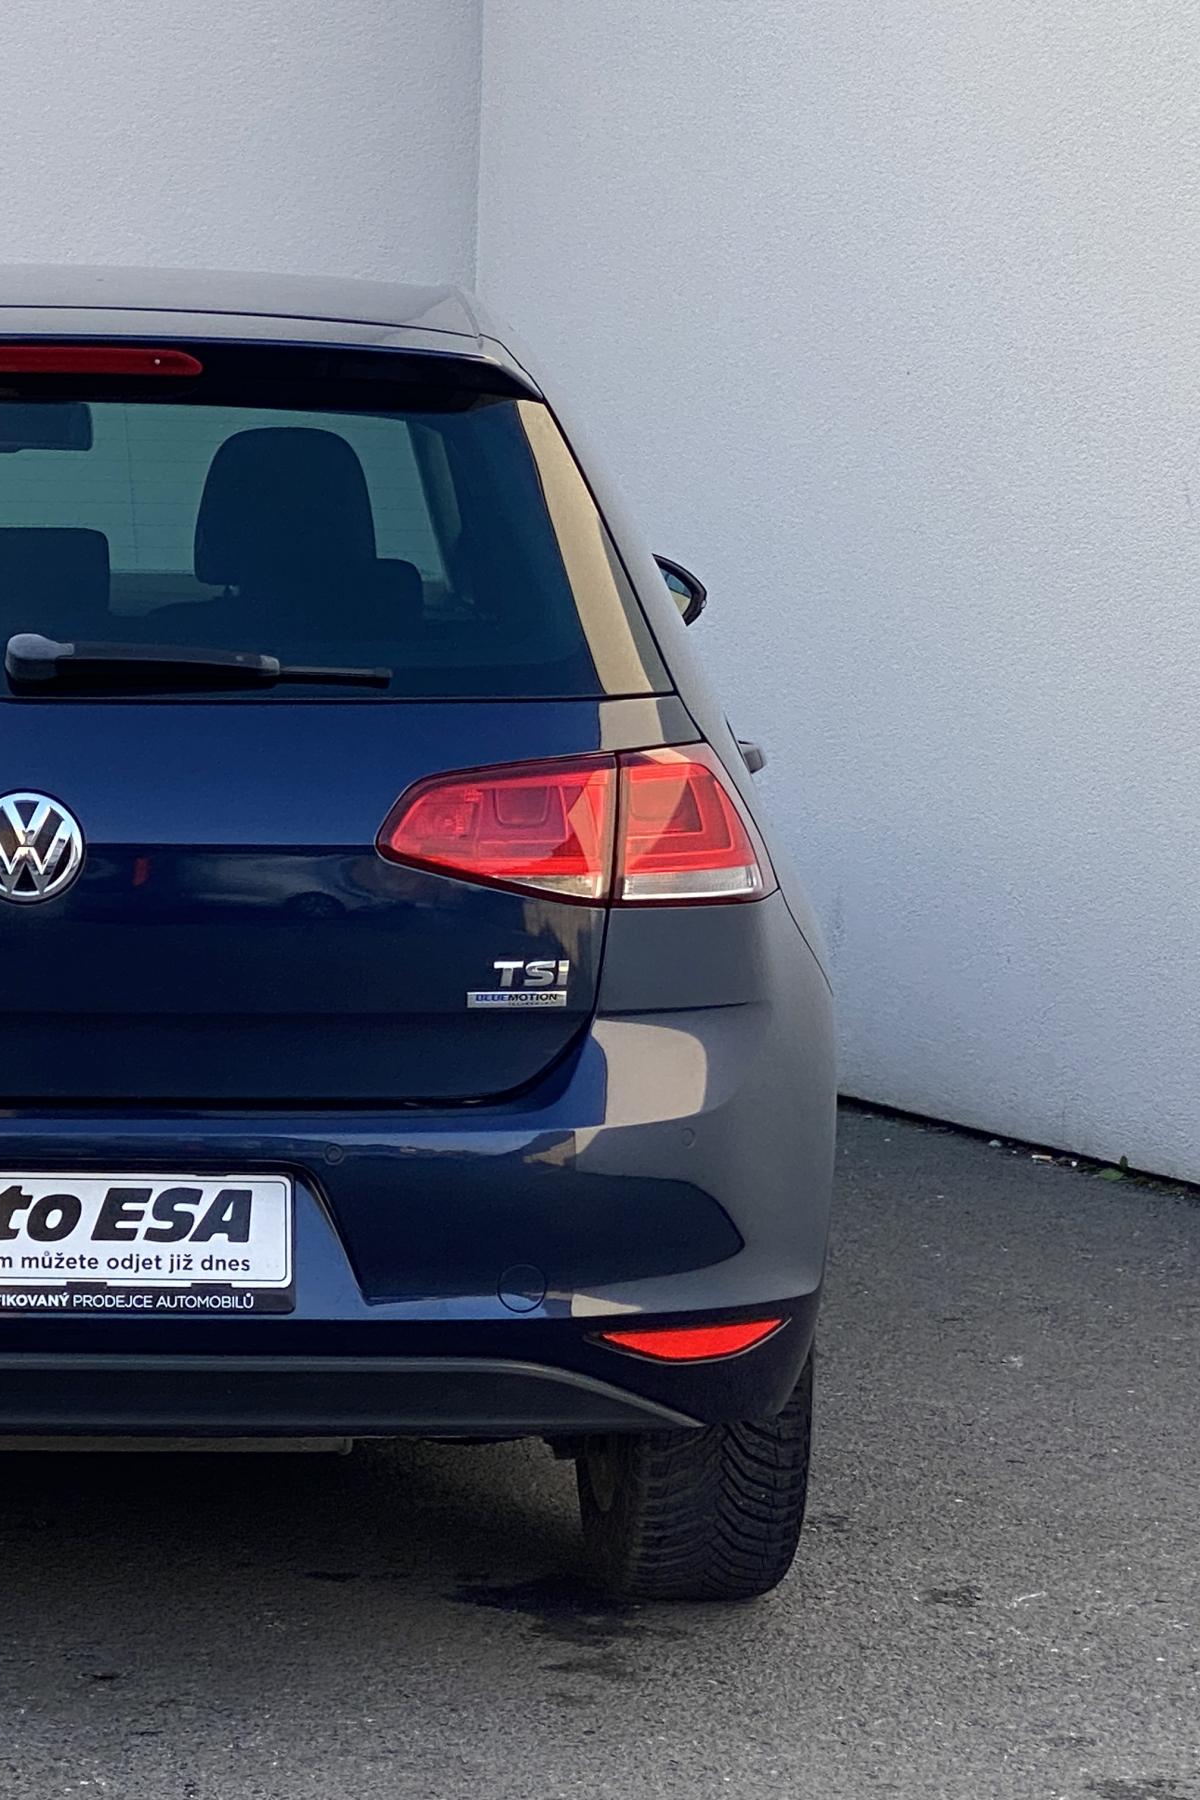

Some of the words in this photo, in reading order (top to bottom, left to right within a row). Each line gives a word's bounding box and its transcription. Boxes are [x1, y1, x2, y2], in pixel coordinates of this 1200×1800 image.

[493, 959, 570, 987] TSI
[90, 1187, 253, 1243] ESA
[20, 1250, 100, 1271] můžete
[106, 1253, 163, 1274] odjet
[167, 1252, 194, 1274] již
[200, 1252, 251, 1272] dnes
[73, 1294, 153, 1309] PRODEJCE
[156, 1291, 255, 1310] AUTOMOBILŮ
